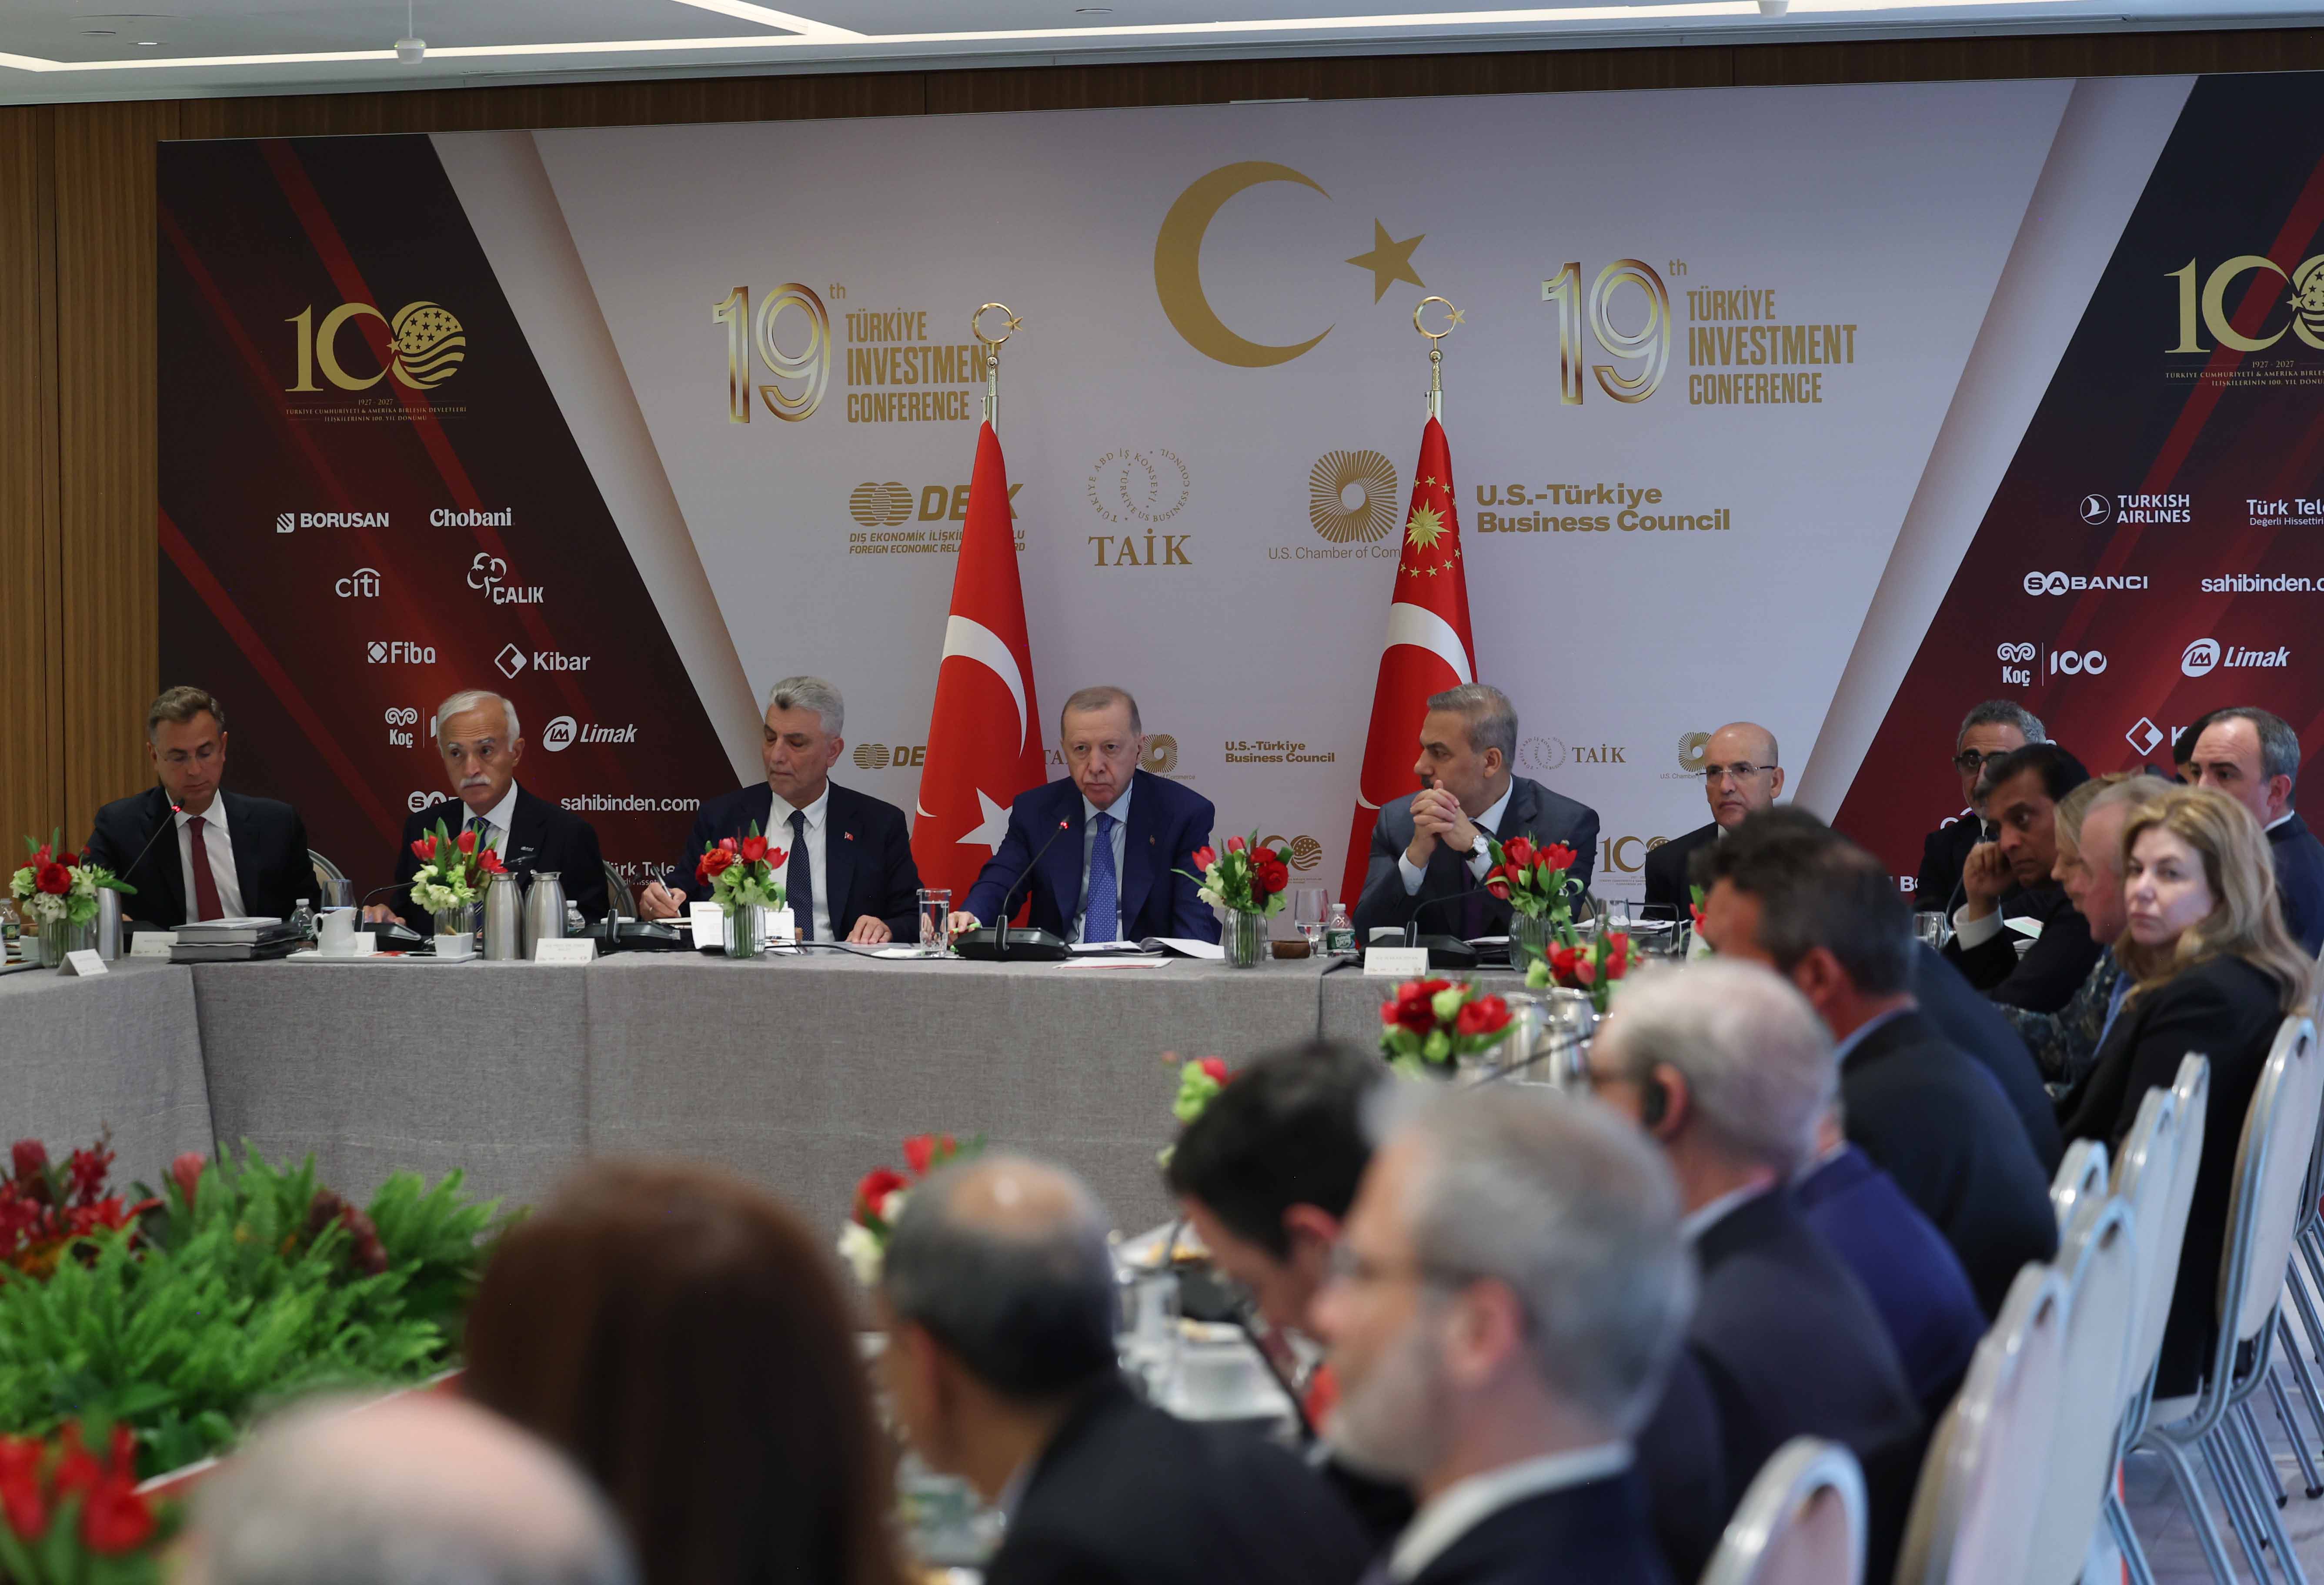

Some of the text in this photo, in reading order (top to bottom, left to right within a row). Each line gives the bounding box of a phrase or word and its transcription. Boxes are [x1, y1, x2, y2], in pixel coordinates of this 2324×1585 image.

[1687, 285, 1775, 321] TÜRKİYE
[845, 308, 927, 342] TÜRKİYE
[1689, 324, 1857, 366] INVESTMENT
[1690, 372, 1823, 405] CONFERENCE
[848, 391, 969, 422] CONFERENCE
[1095, 452, 1114, 471] ABD
[1161, 448, 1190, 487] COUNCIL
[1153, 490, 1189, 522] BUSINESS
[1476, 483, 1662, 509] U.S.-Türkiye
[2117, 494, 2190, 508] TURKISH
[2117, 509, 2190, 523] AIRLINES
[2246, 498, 2324, 515] Türk Tel
[301, 512, 389, 528] BORUSAN
[430, 508, 512, 527] Chobani
[1478, 509, 1730, 532] Business Council
[2250, 517, 2324, 527] Değerli Hissettiri
[850, 532, 866, 544] DIŞ
[870, 530, 925, 542] EKONOMİK
[1088, 528, 1192, 566] TAİK
[849, 545, 888, 554] FOREIGN
[890, 544, 937, 553] ECONOMIC
[1269, 547, 1292, 559] U.S.
[1296, 546, 1352, 559] Chamber
[1356, 546, 1368, 558] of
[335, 568, 381, 598] citi
[2023, 571, 2148, 596] SABANCI
[2201, 574, 2324, 592] sahibinden.c
[493, 587, 544, 605] ÇALIK
[391, 641, 435, 664] Fiba
[534, 651, 591, 671] Kibar
[2224, 646, 2291, 667] Limak
[2003, 666, 2030, 686] Koç
[390, 729, 413, 748] Koç
[580, 723, 638, 743] Limak
[892, 746, 926, 766] DE
[1225, 741, 1306, 752] U.S.-Türkiye
[1572, 743, 1626, 763] TAİK
[1225, 752, 1335, 762] Business Council
[561, 794, 700, 811] sahibinden.com
